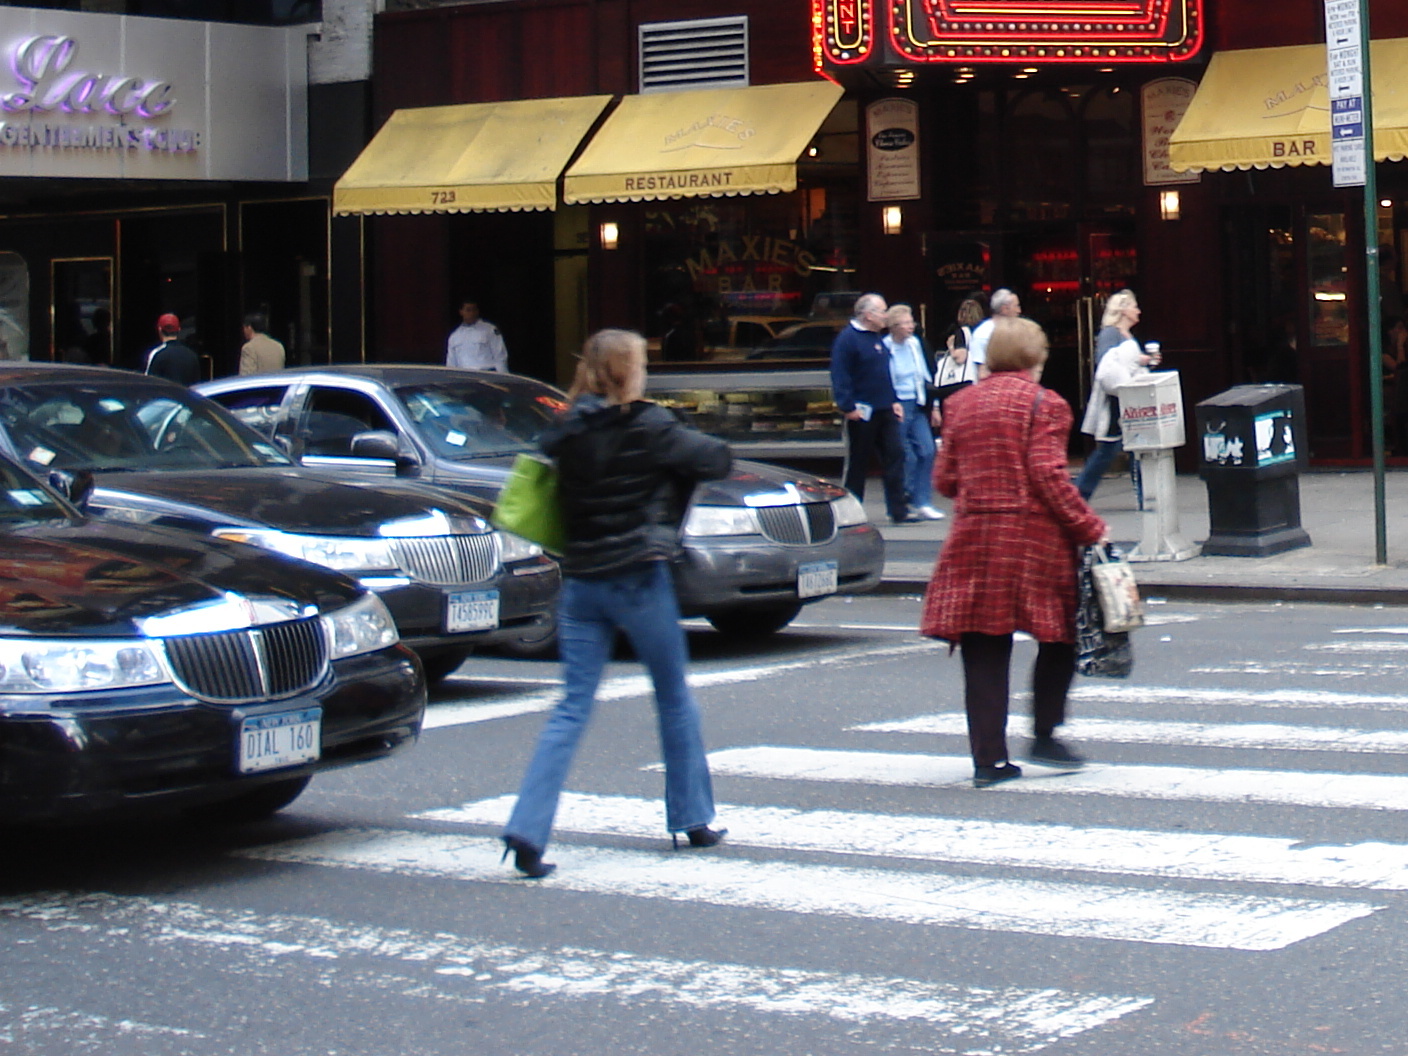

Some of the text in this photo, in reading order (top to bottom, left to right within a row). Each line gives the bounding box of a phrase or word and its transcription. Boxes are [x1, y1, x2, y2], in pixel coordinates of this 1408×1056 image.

[2, 34, 177, 118] Lace
[1273, 140, 1316, 157] BAR
[624, 172, 734, 192] RESTAURANT
[431, 190, 456, 205] 723
[684, 235, 817, 281] MAXIE'S
[718, 273, 783, 294] BAR
[247, 730, 279, 759] DIAL
